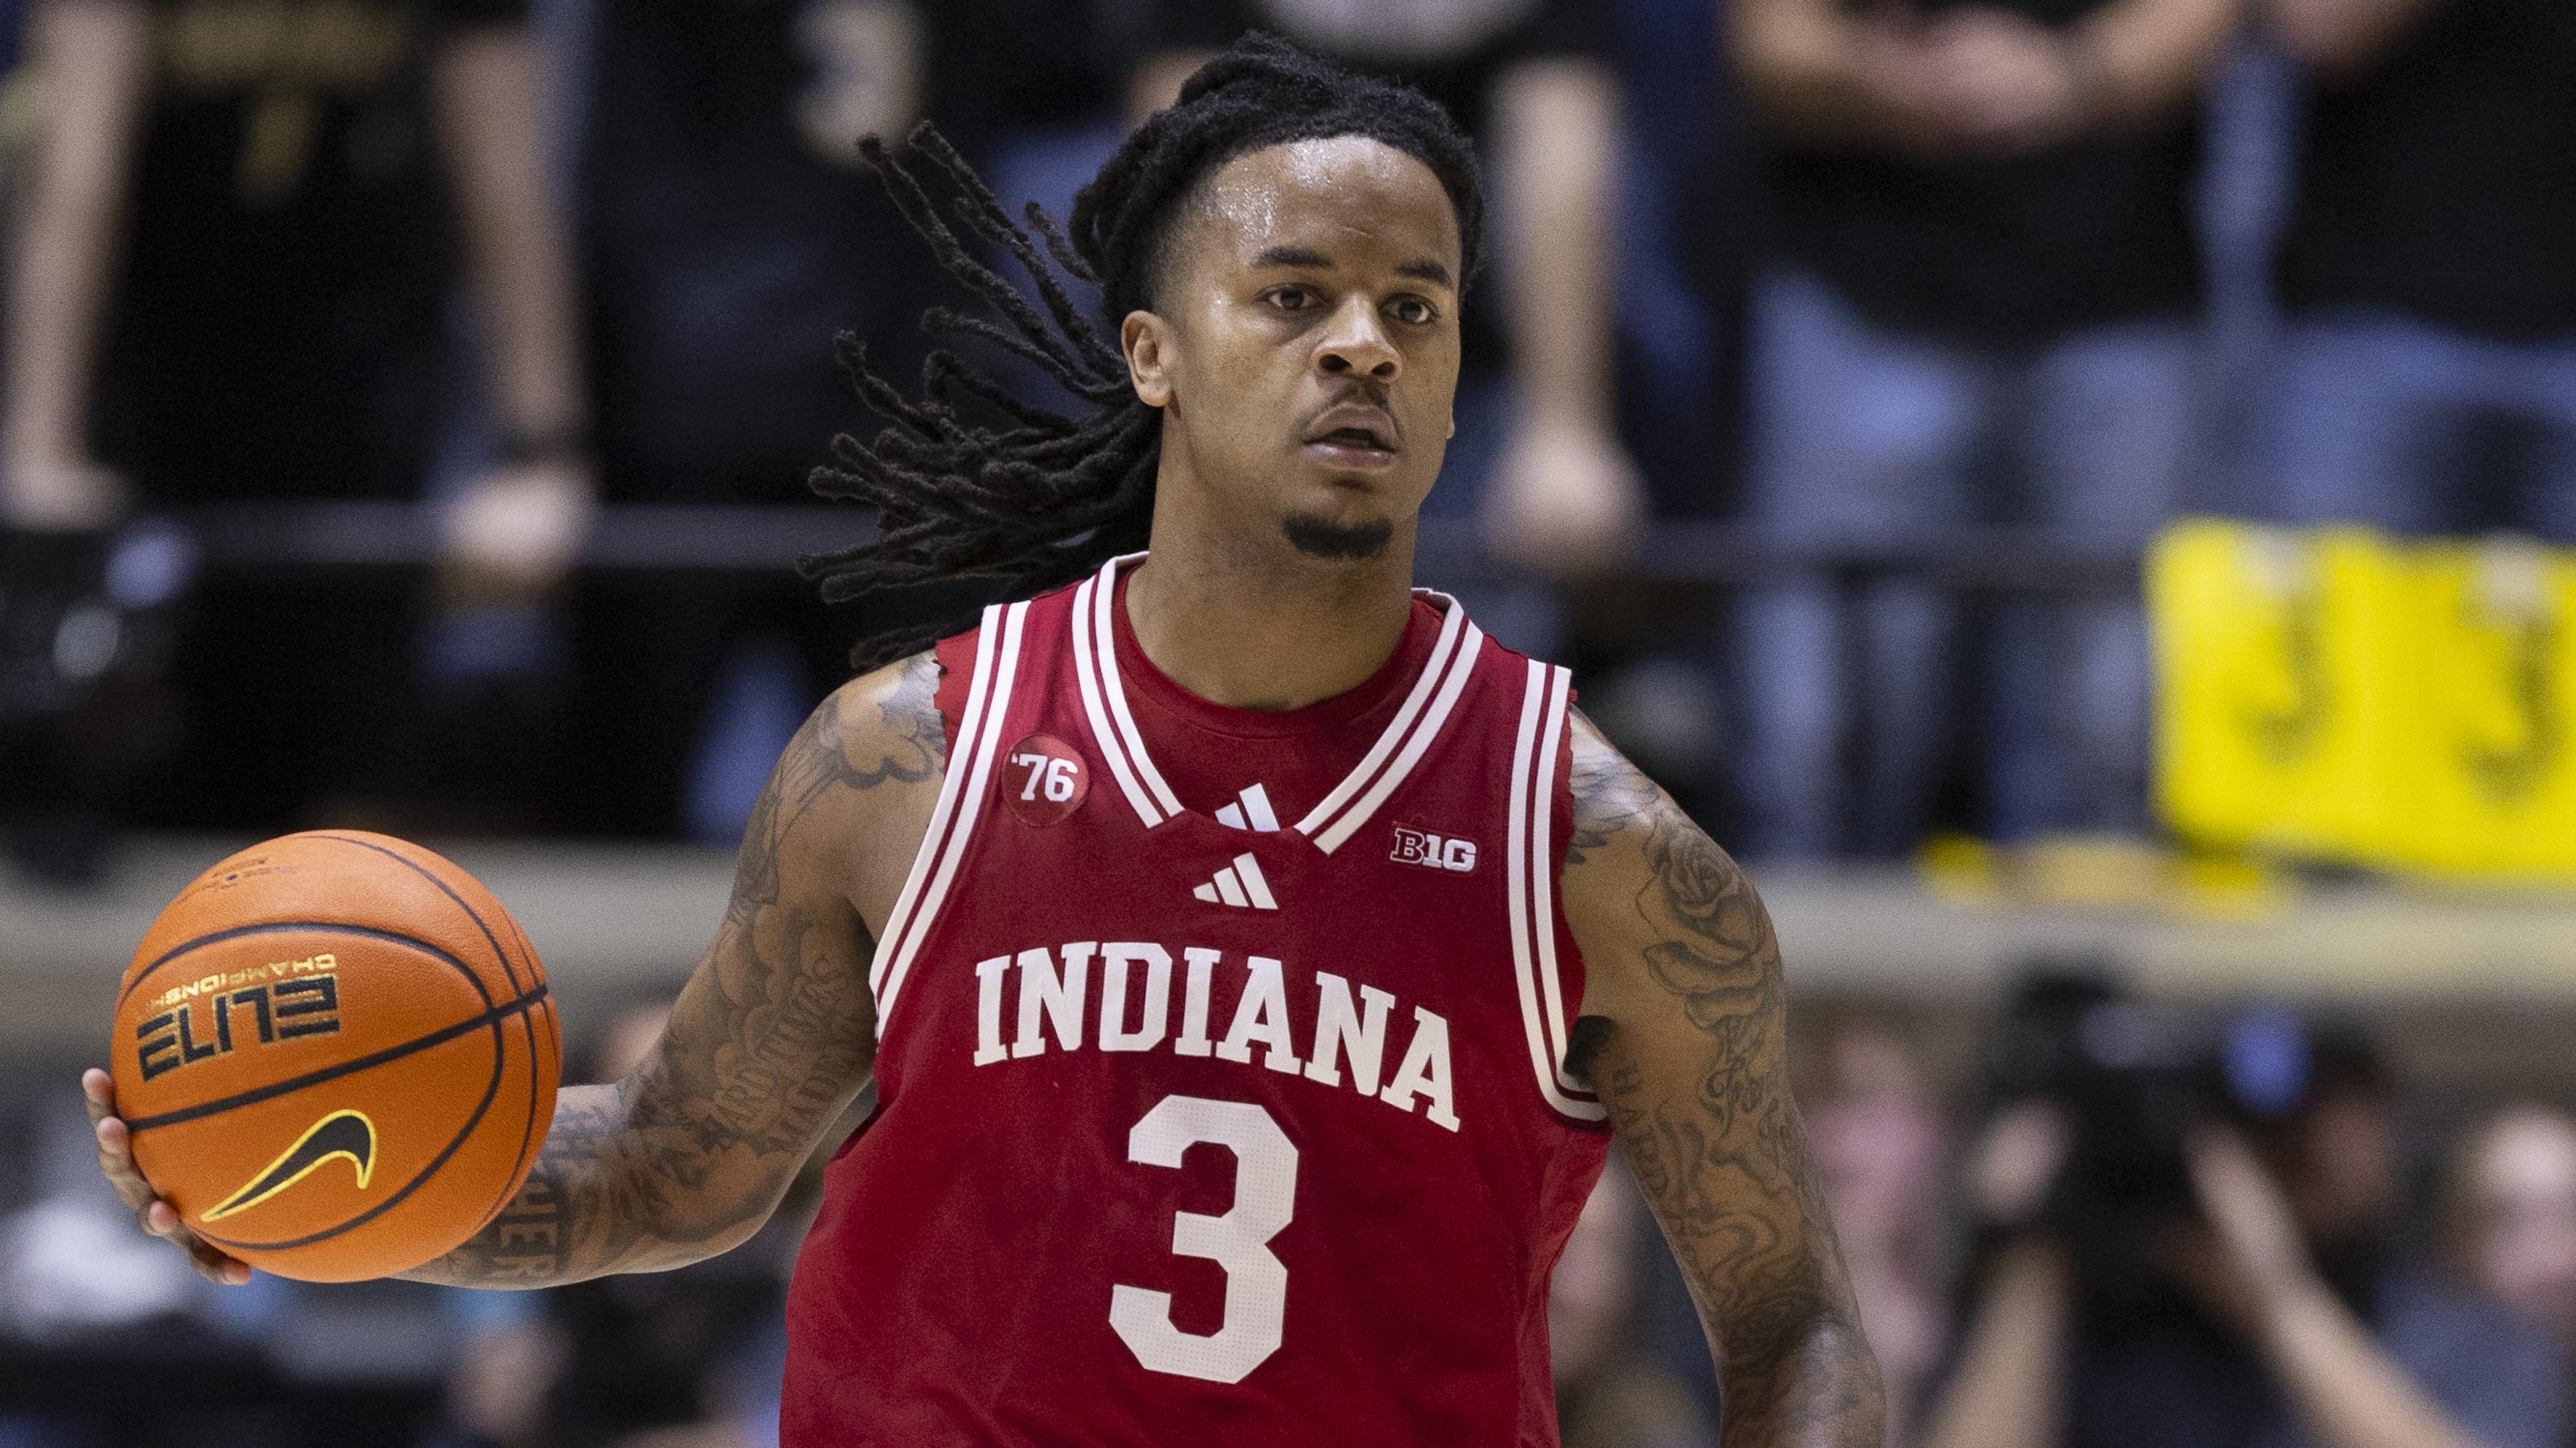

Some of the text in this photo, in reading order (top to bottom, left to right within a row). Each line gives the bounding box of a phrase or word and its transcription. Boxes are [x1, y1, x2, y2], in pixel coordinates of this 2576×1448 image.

[1011, 753, 1078, 802] '76
[136, 974, 341, 1084] ELITE
[974, 940, 1461, 1133] INDIANA
[1109, 1095, 1298, 1384] 3
